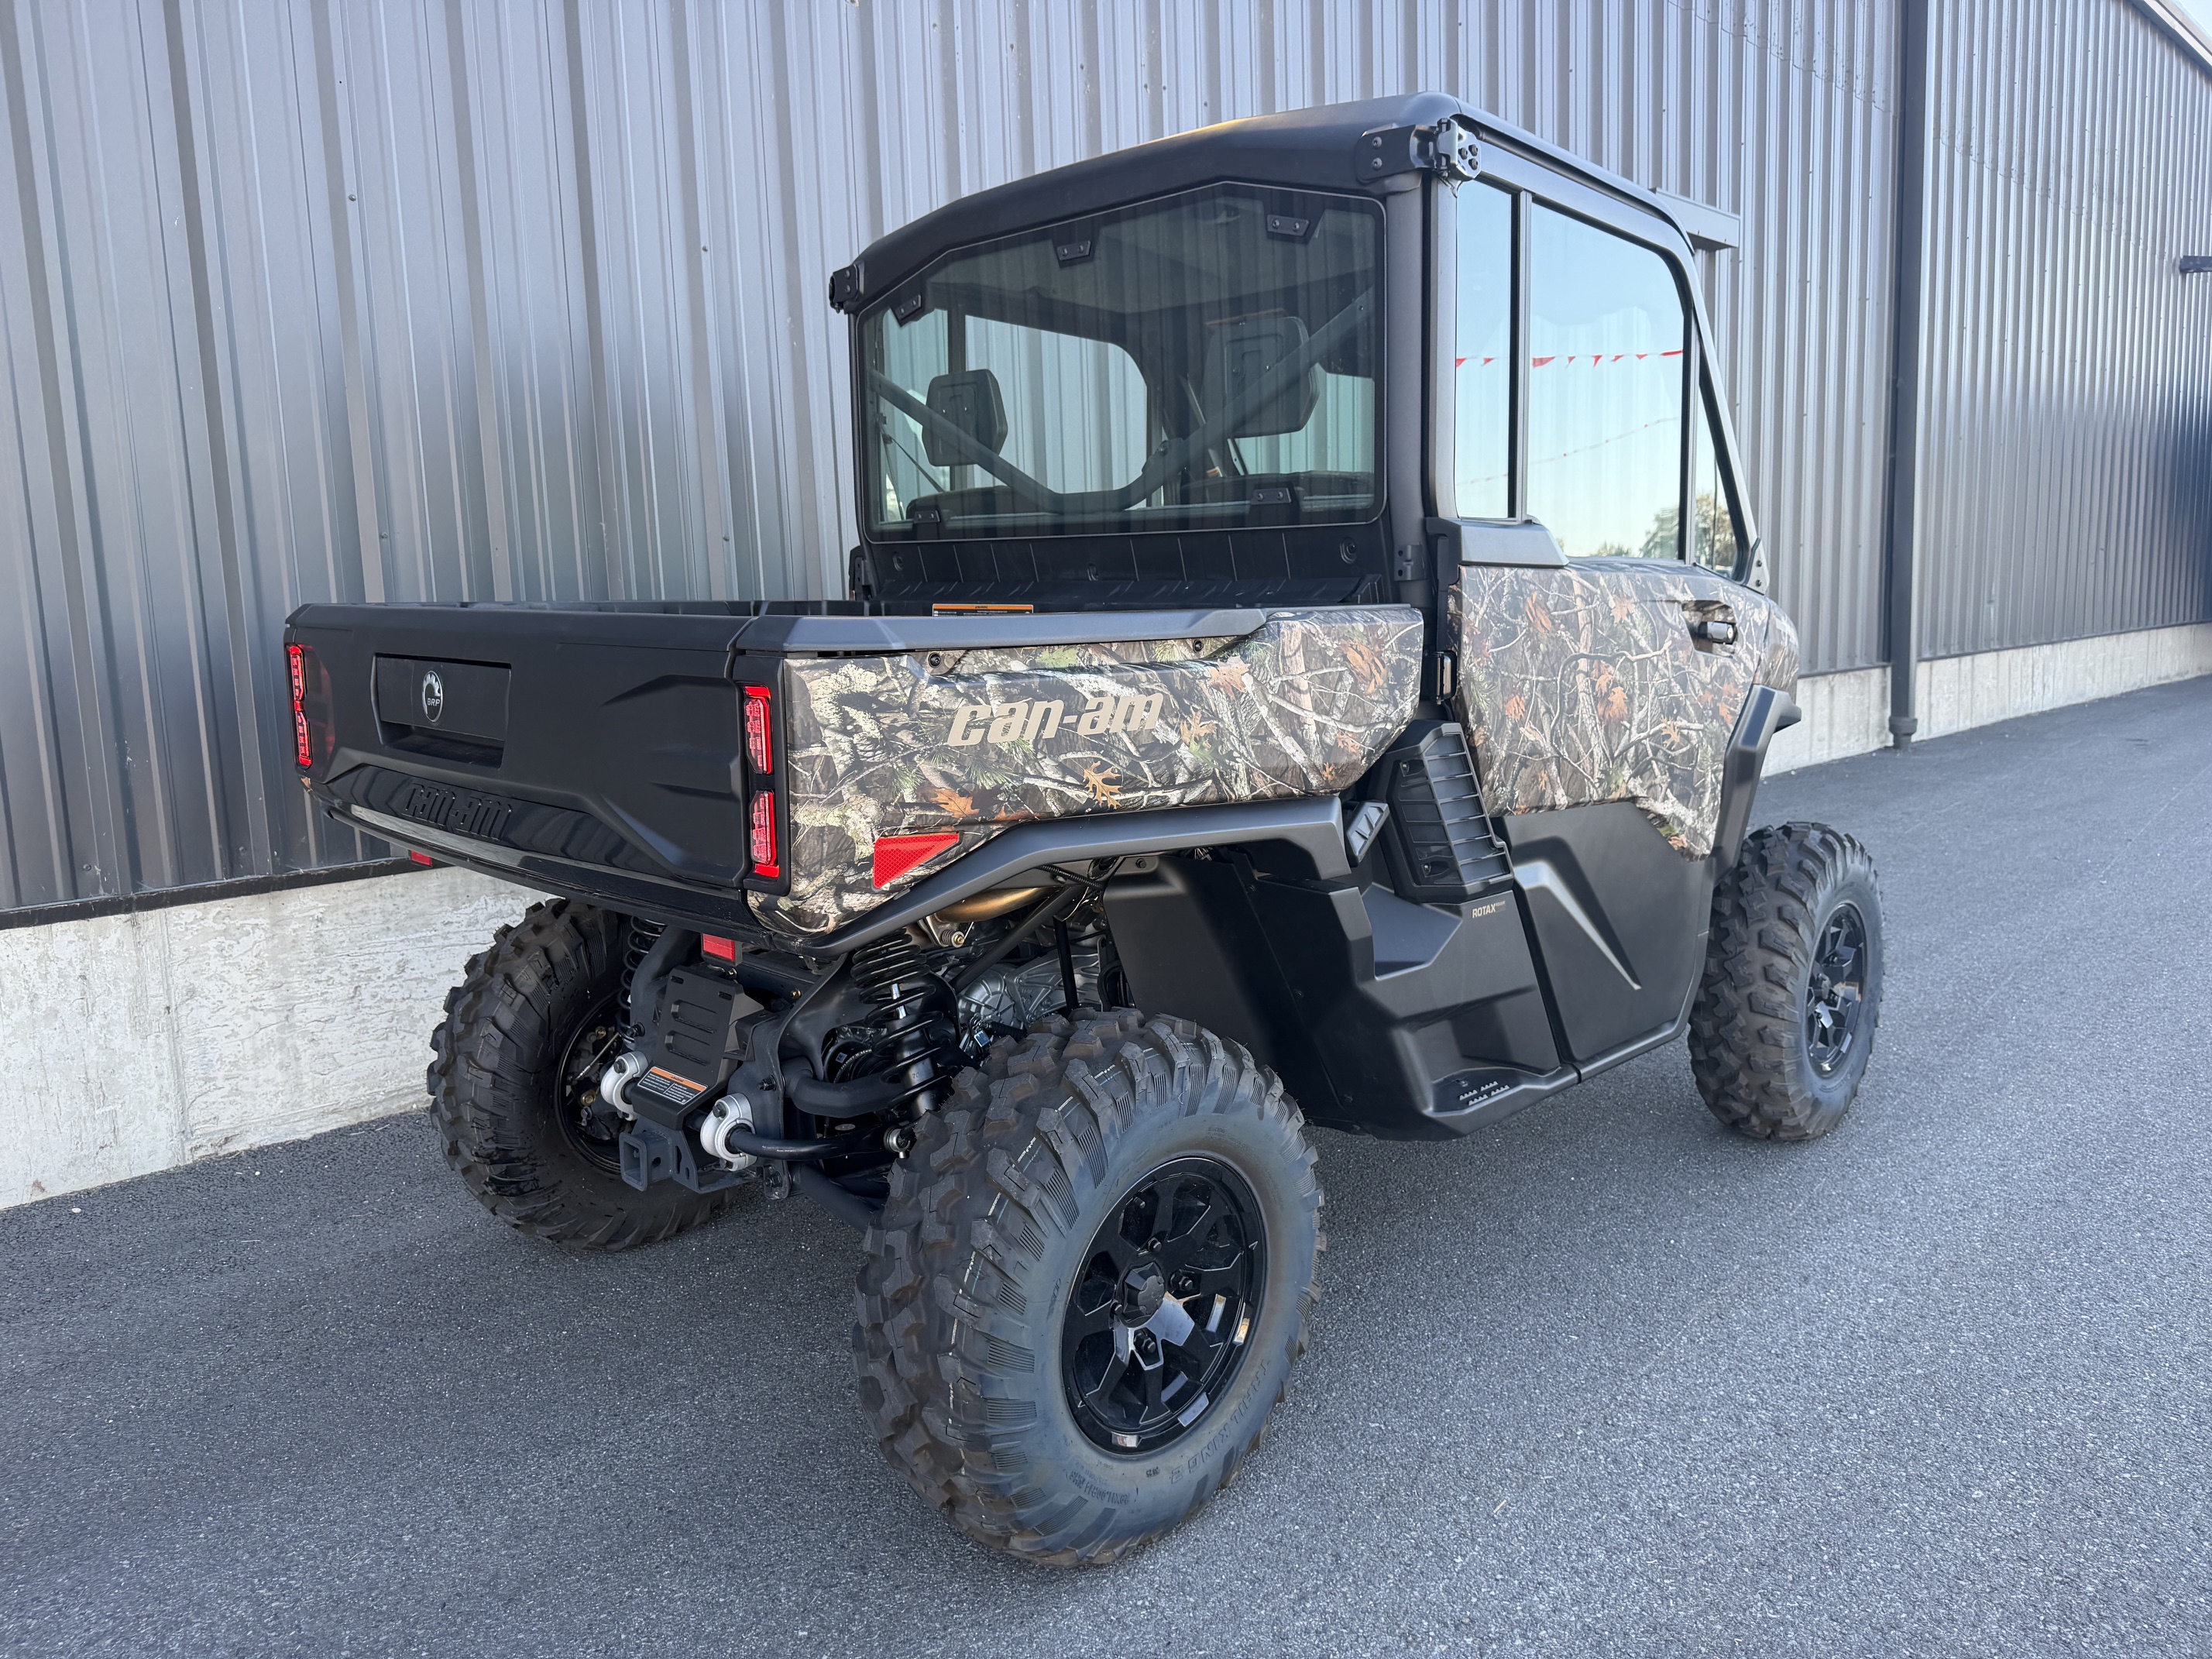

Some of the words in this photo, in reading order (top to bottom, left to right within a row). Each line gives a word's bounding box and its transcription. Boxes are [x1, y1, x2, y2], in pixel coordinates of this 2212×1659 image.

[427, 697, 441, 706] BRP
[1472, 903, 1496, 919] ROTAX
[1230, 1359, 1270, 1424] TRAIL
[1188, 1423, 1231, 1473] KING
